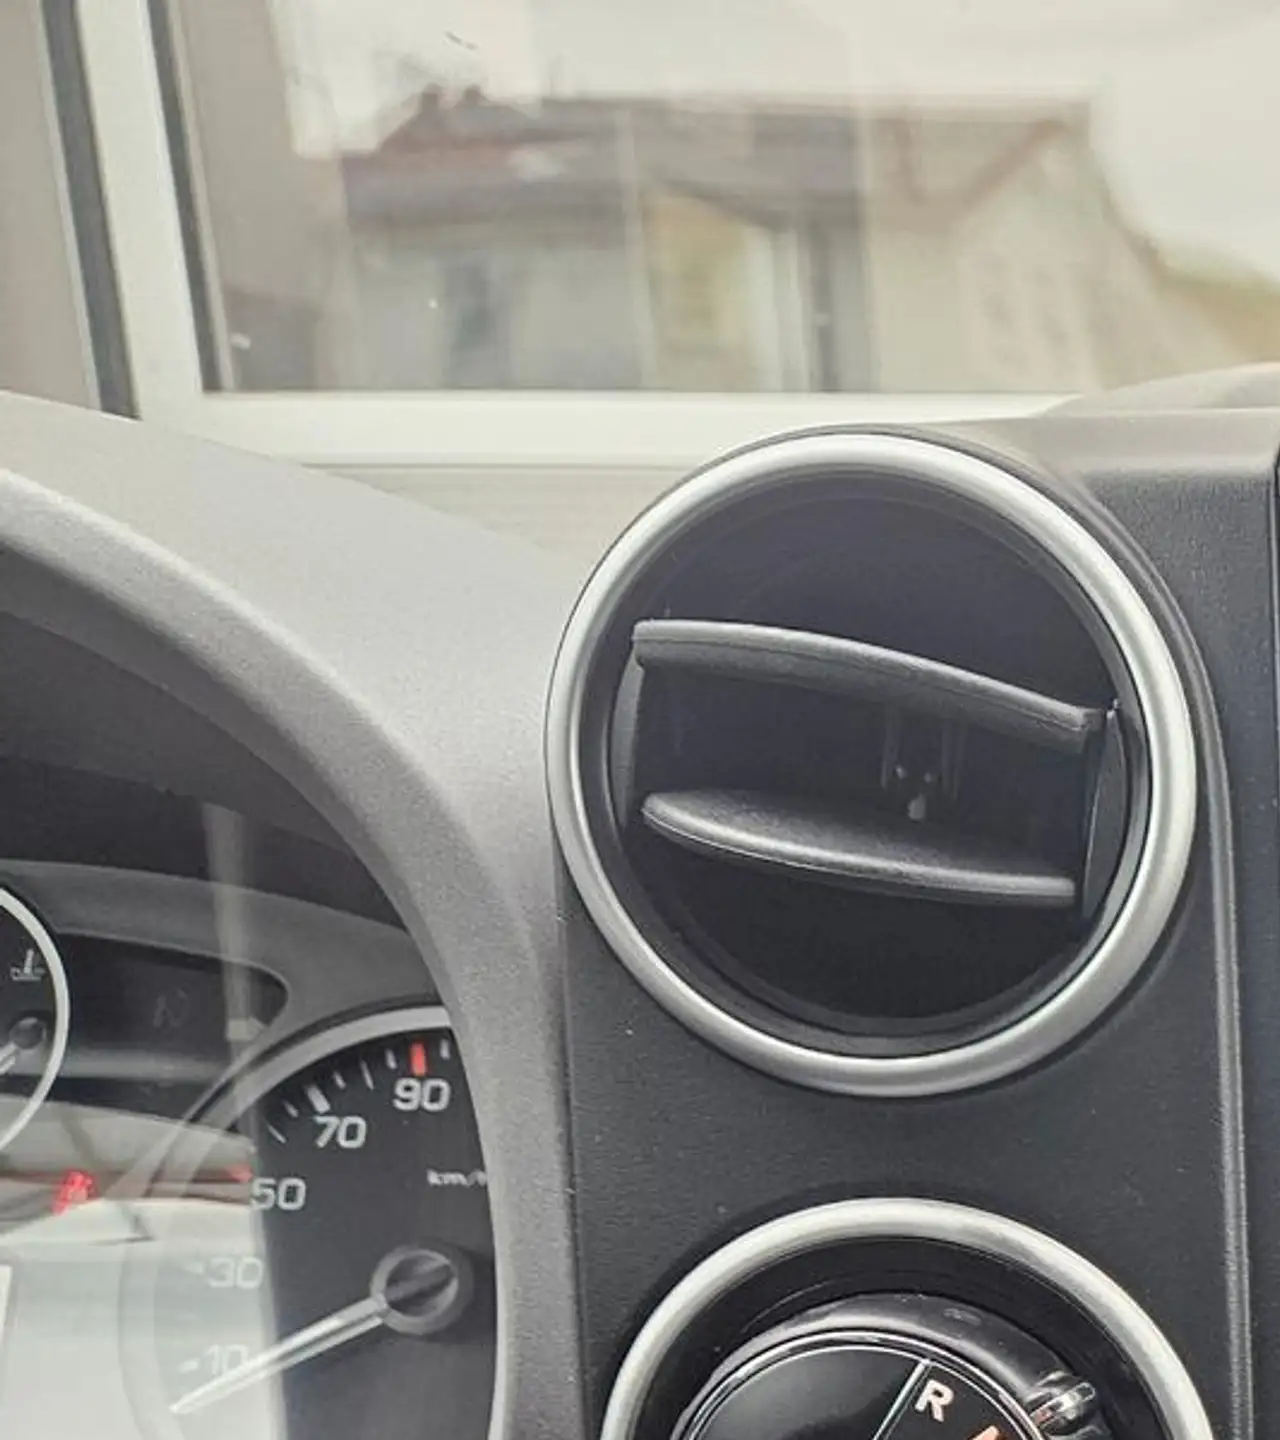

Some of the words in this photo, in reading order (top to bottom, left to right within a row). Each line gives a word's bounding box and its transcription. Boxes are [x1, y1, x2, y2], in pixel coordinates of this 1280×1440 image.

[393, 1079, 450, 1112] 90
[313, 1115, 367, 1149] 70
[251, 1177, 306, 1211] 50
[208, 1256, 264, 1289] 30
[914, 1379, 954, 1422] R
